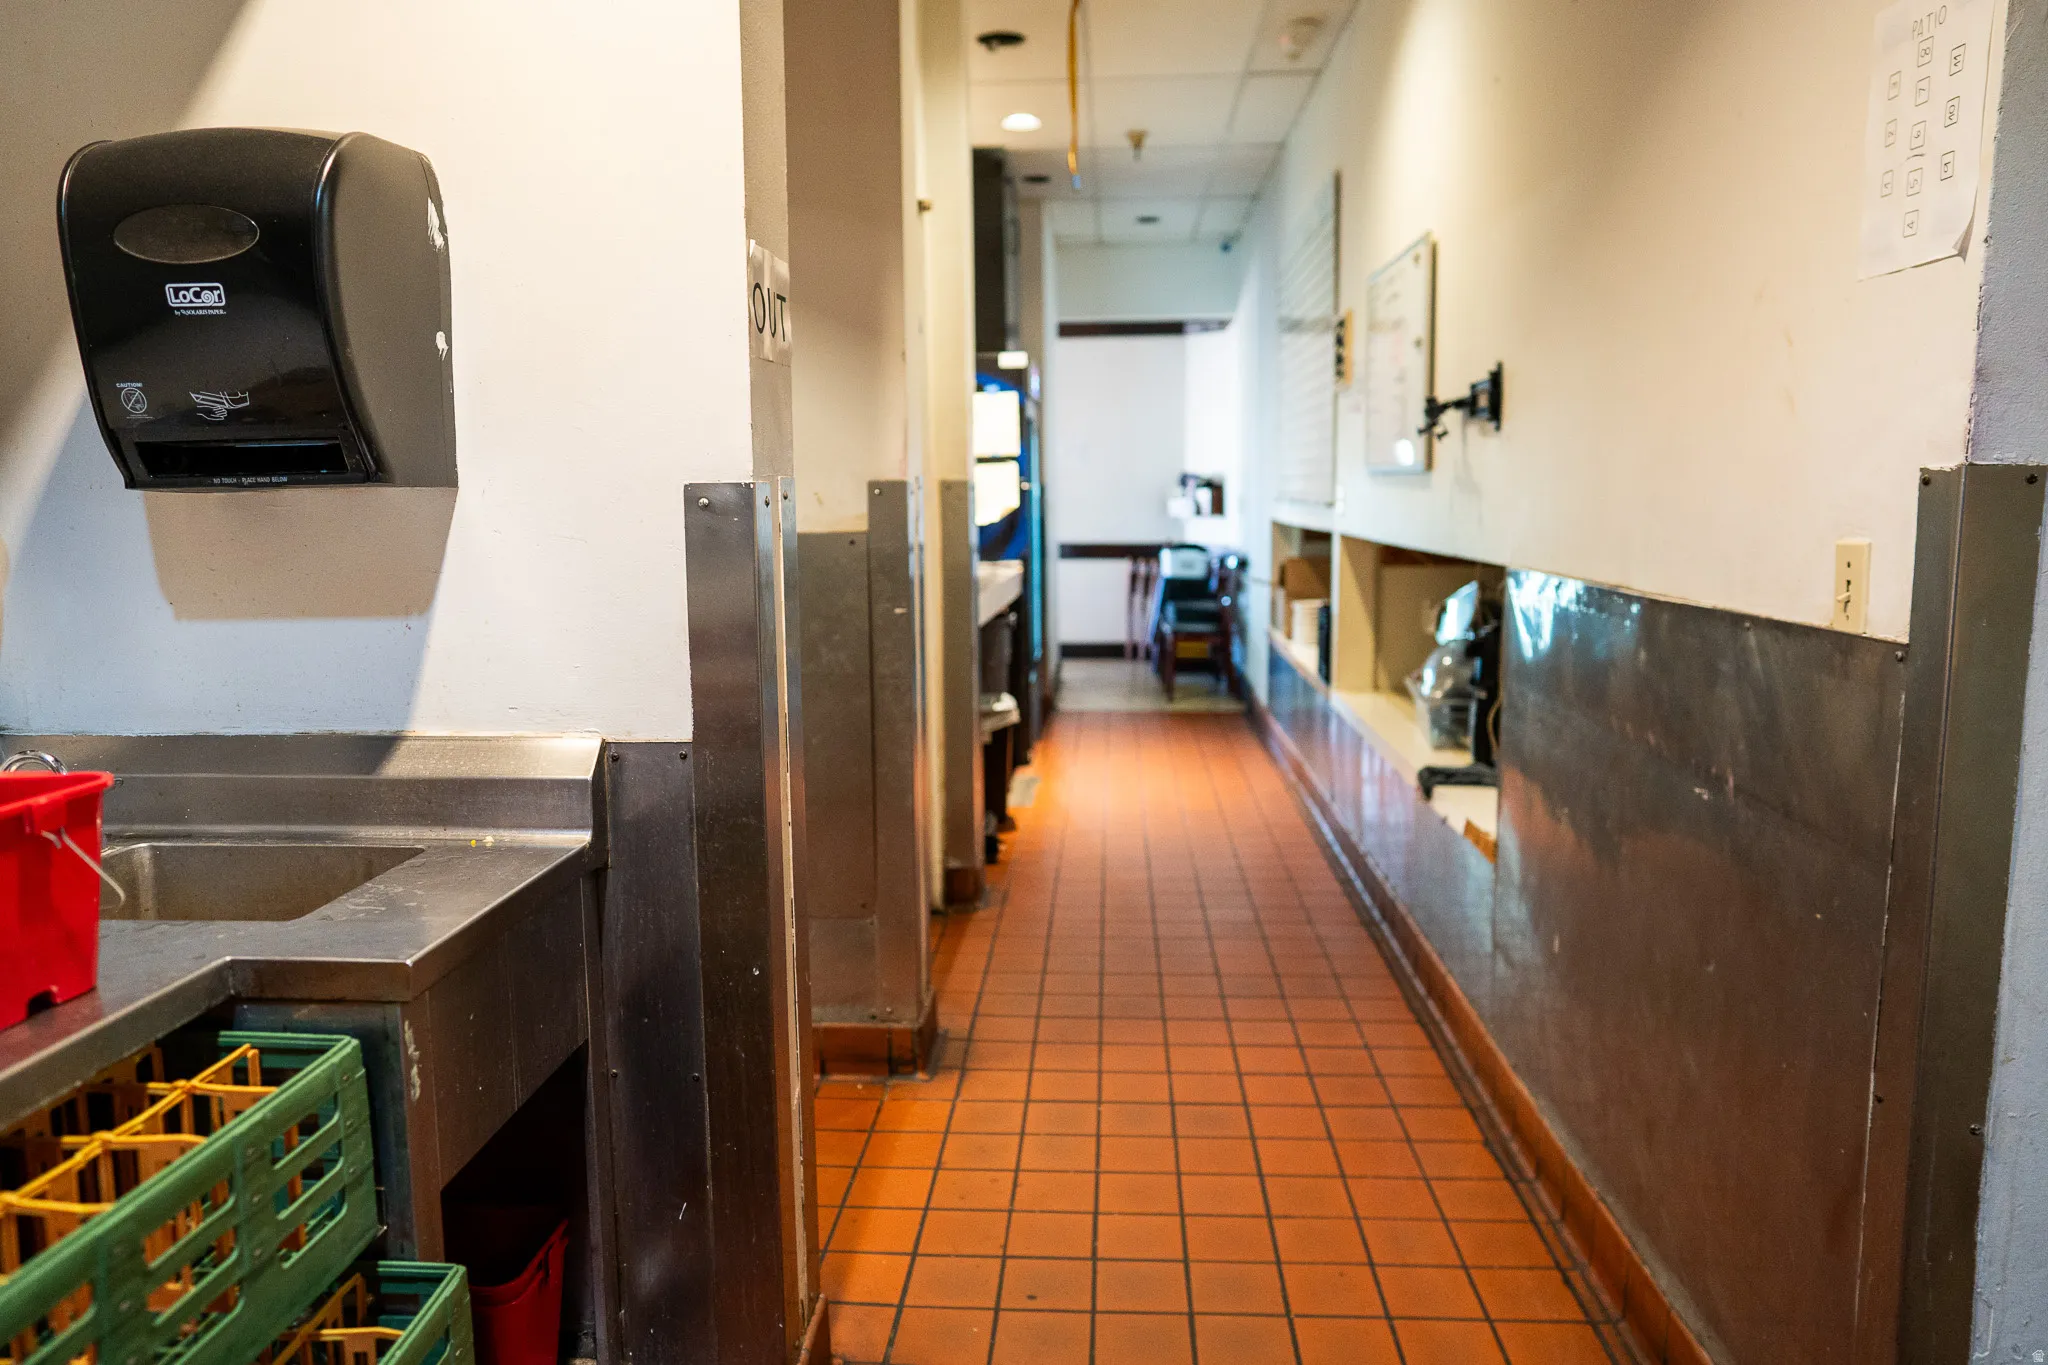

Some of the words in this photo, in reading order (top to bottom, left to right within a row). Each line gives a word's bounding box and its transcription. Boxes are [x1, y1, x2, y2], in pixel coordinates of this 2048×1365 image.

[1912, 5, 1947, 40] PATIO
[1920, 46, 1931, 58] 8
[1953, 54, 1962, 67] 11
[1918, 88, 1926, 98] 7
[1948, 104, 1956, 120] 10
[1913, 130, 1921, 139] 6
[1943, 161, 1951, 173] 9
[1910, 178, 1918, 189] 5
[1906, 220, 1915, 229] 4
[168, 287, 221, 303] LoCor
[752, 282, 787, 342] OUT
